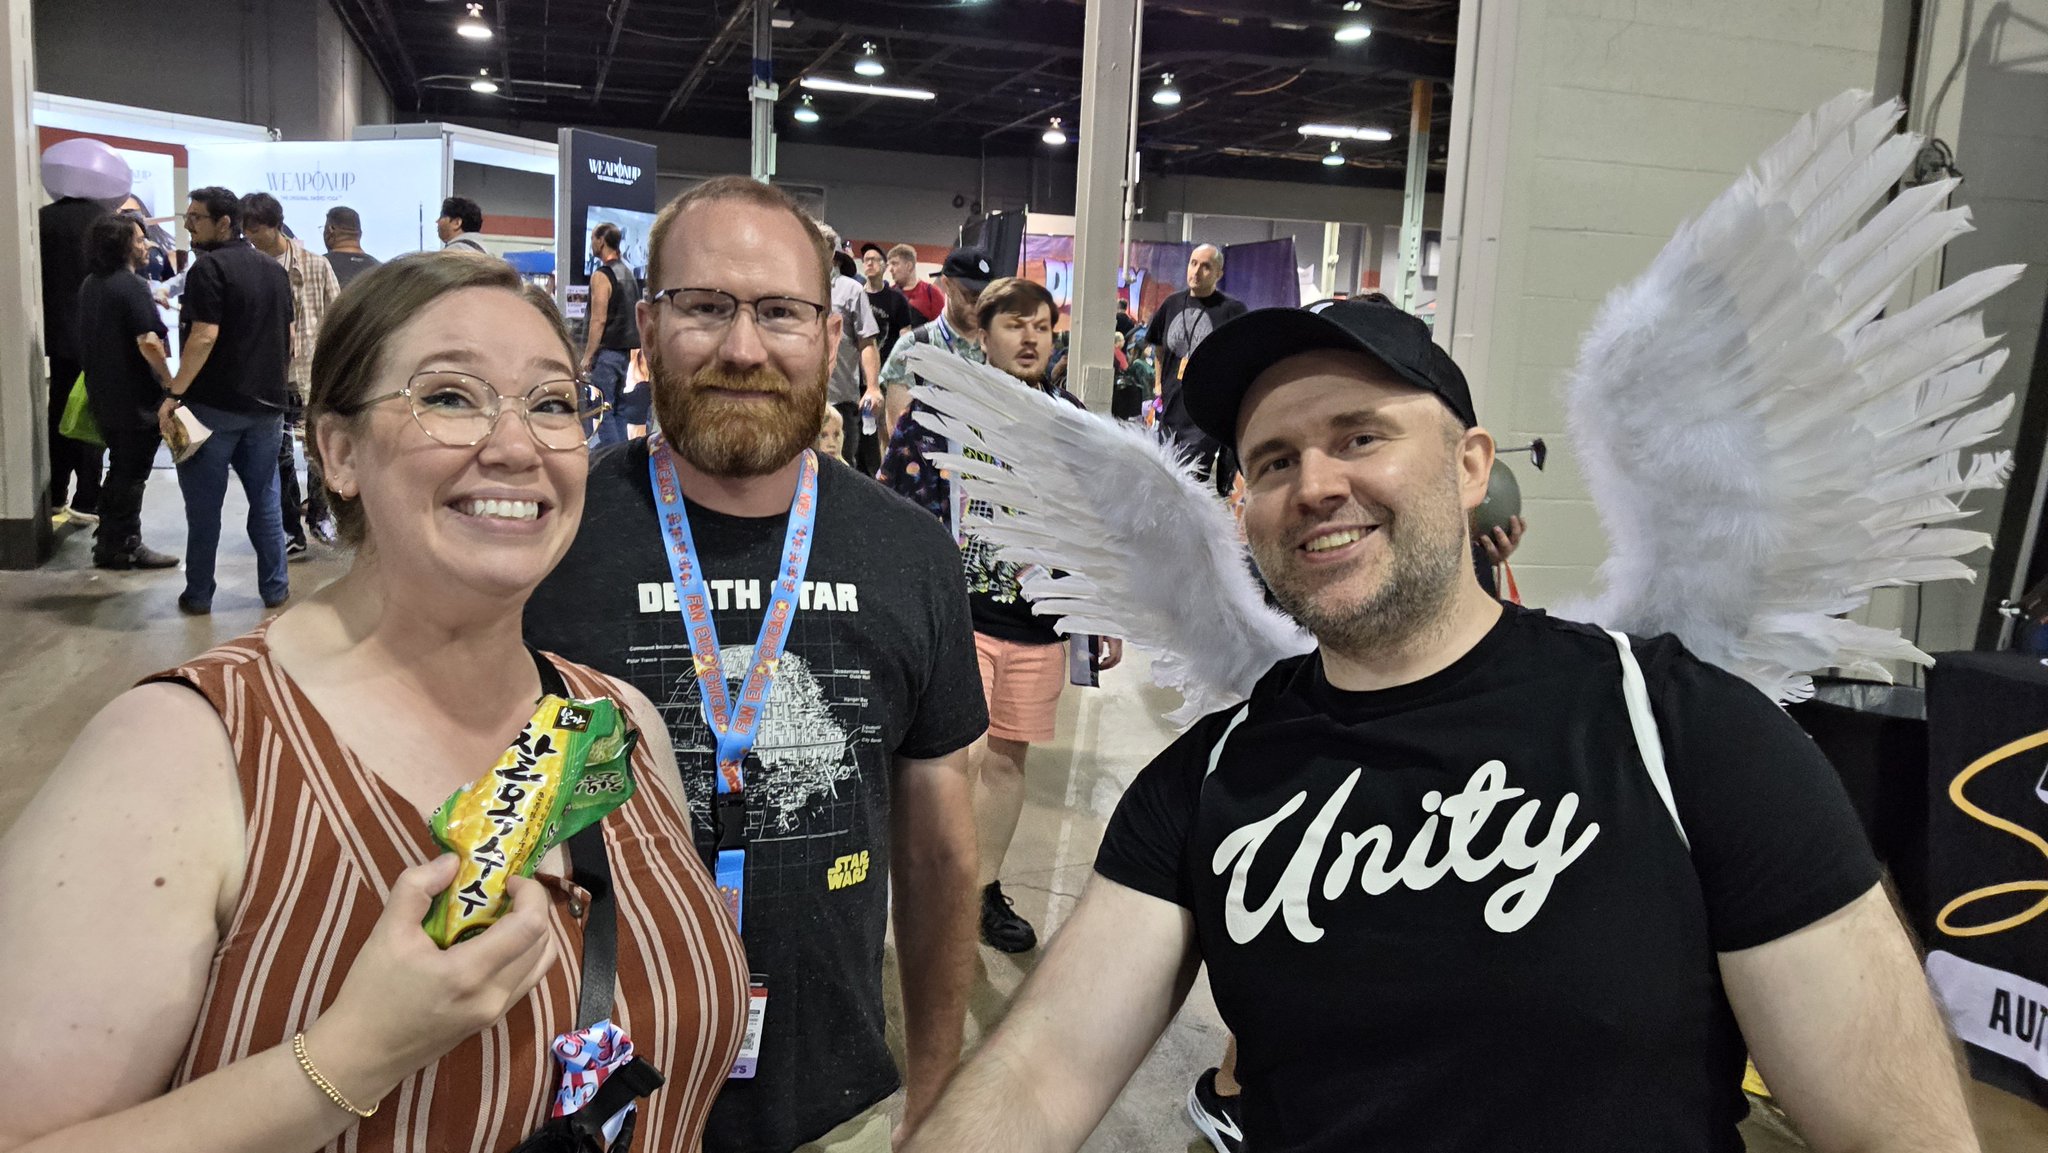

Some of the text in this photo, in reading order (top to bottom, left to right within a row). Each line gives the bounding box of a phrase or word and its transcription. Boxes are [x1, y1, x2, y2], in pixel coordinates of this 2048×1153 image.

[266, 168, 356, 191] WEAPONUP
[589, 157, 641, 181] WEAPONUP
[638, 579, 761, 612] DETH
[685, 594, 706, 623] FAN
[771, 581, 859, 612] TAR
[693, 625, 718, 667] EXPO
[732, 599, 791, 735] FAN EXPO CHICAGO
[458, 721, 556, 918] 찰옥수수
[828, 850, 870, 874] STAR
[1212, 759, 1600, 945] Unity
[828, 864, 868, 890] WARS
